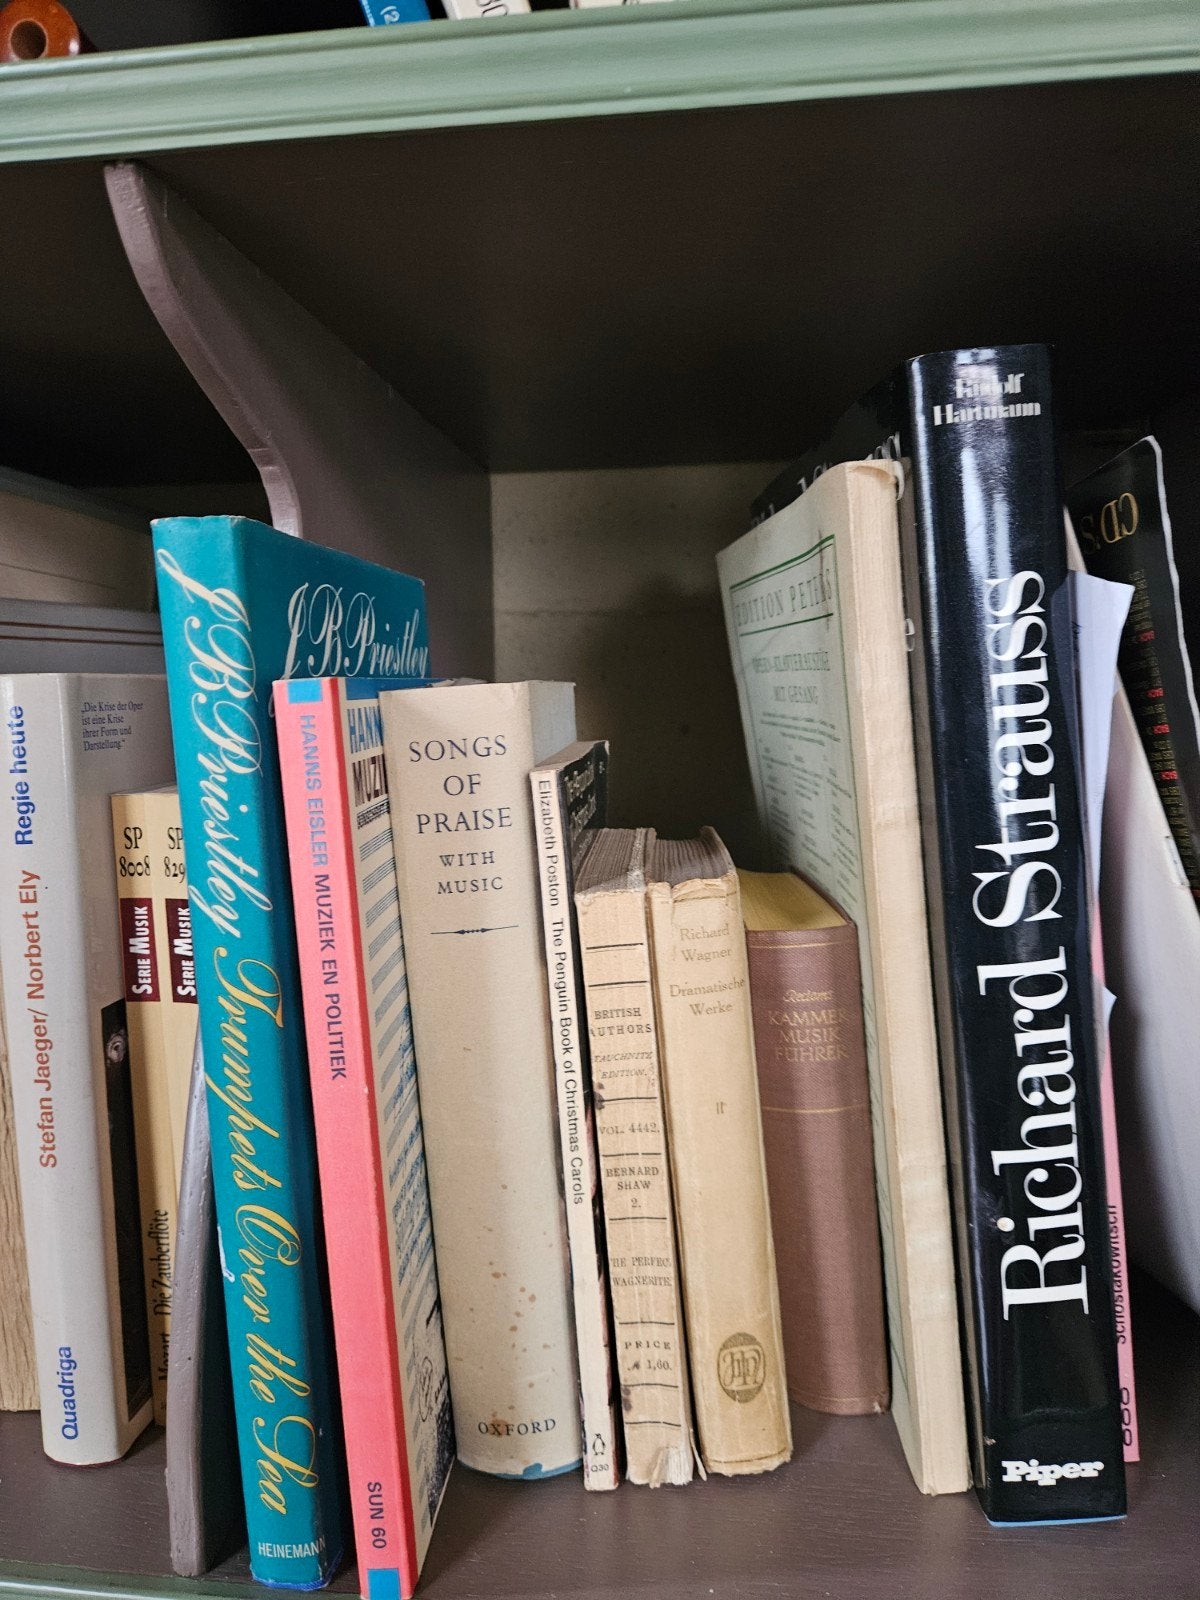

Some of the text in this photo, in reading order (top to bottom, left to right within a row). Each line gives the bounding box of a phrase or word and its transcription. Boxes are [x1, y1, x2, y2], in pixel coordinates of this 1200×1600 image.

[7, 704, 27, 774] heute
[408, 734, 508, 763] SONGS
[443, 774, 482, 796] OF
[12, 781, 36, 846] Regie
[416, 807, 513, 834] PRAISE
[124, 826, 143, 850] SP
[119, 855, 151, 877] 8008
[163, 856, 186, 884] 829
[439, 850, 495, 868] WITH
[19, 869, 41, 903] Ely
[300, 714, 347, 1081] HANNS EISLER MUZIEK EN POLITIEK
[437, 876, 504, 895] MUSIC
[679, 923, 730, 942] Richard
[971, 569, 1089, 1322] Richard Strauss
[23, 910, 45, 1001] Norbert
[681, 948, 733, 963] Wagner
[538, 780, 584, 1205] Elizabeth Poston The Penguin Book of Christmas Carols
[594, 1007, 642, 1020] BRITISH
[689, 1001, 734, 1017] Werke
[32, 1097, 57, 1169] Stefan
[606, 1166, 659, 1178] BERNARD
[617, 1180, 651, 1191] SHAW
[204, 946, 320, 1516] Trumpets Over the Sea
[624, 1340, 672, 1350] PRICE
[56, 1346, 79, 1441] Quadriga
[477, 1418, 557, 1436] OXFORD
[1001, 1458, 1104, 1486] Piper
[367, 1481, 387, 1549] SUN 60
[257, 1535, 326, 1559] HEINEMANN
